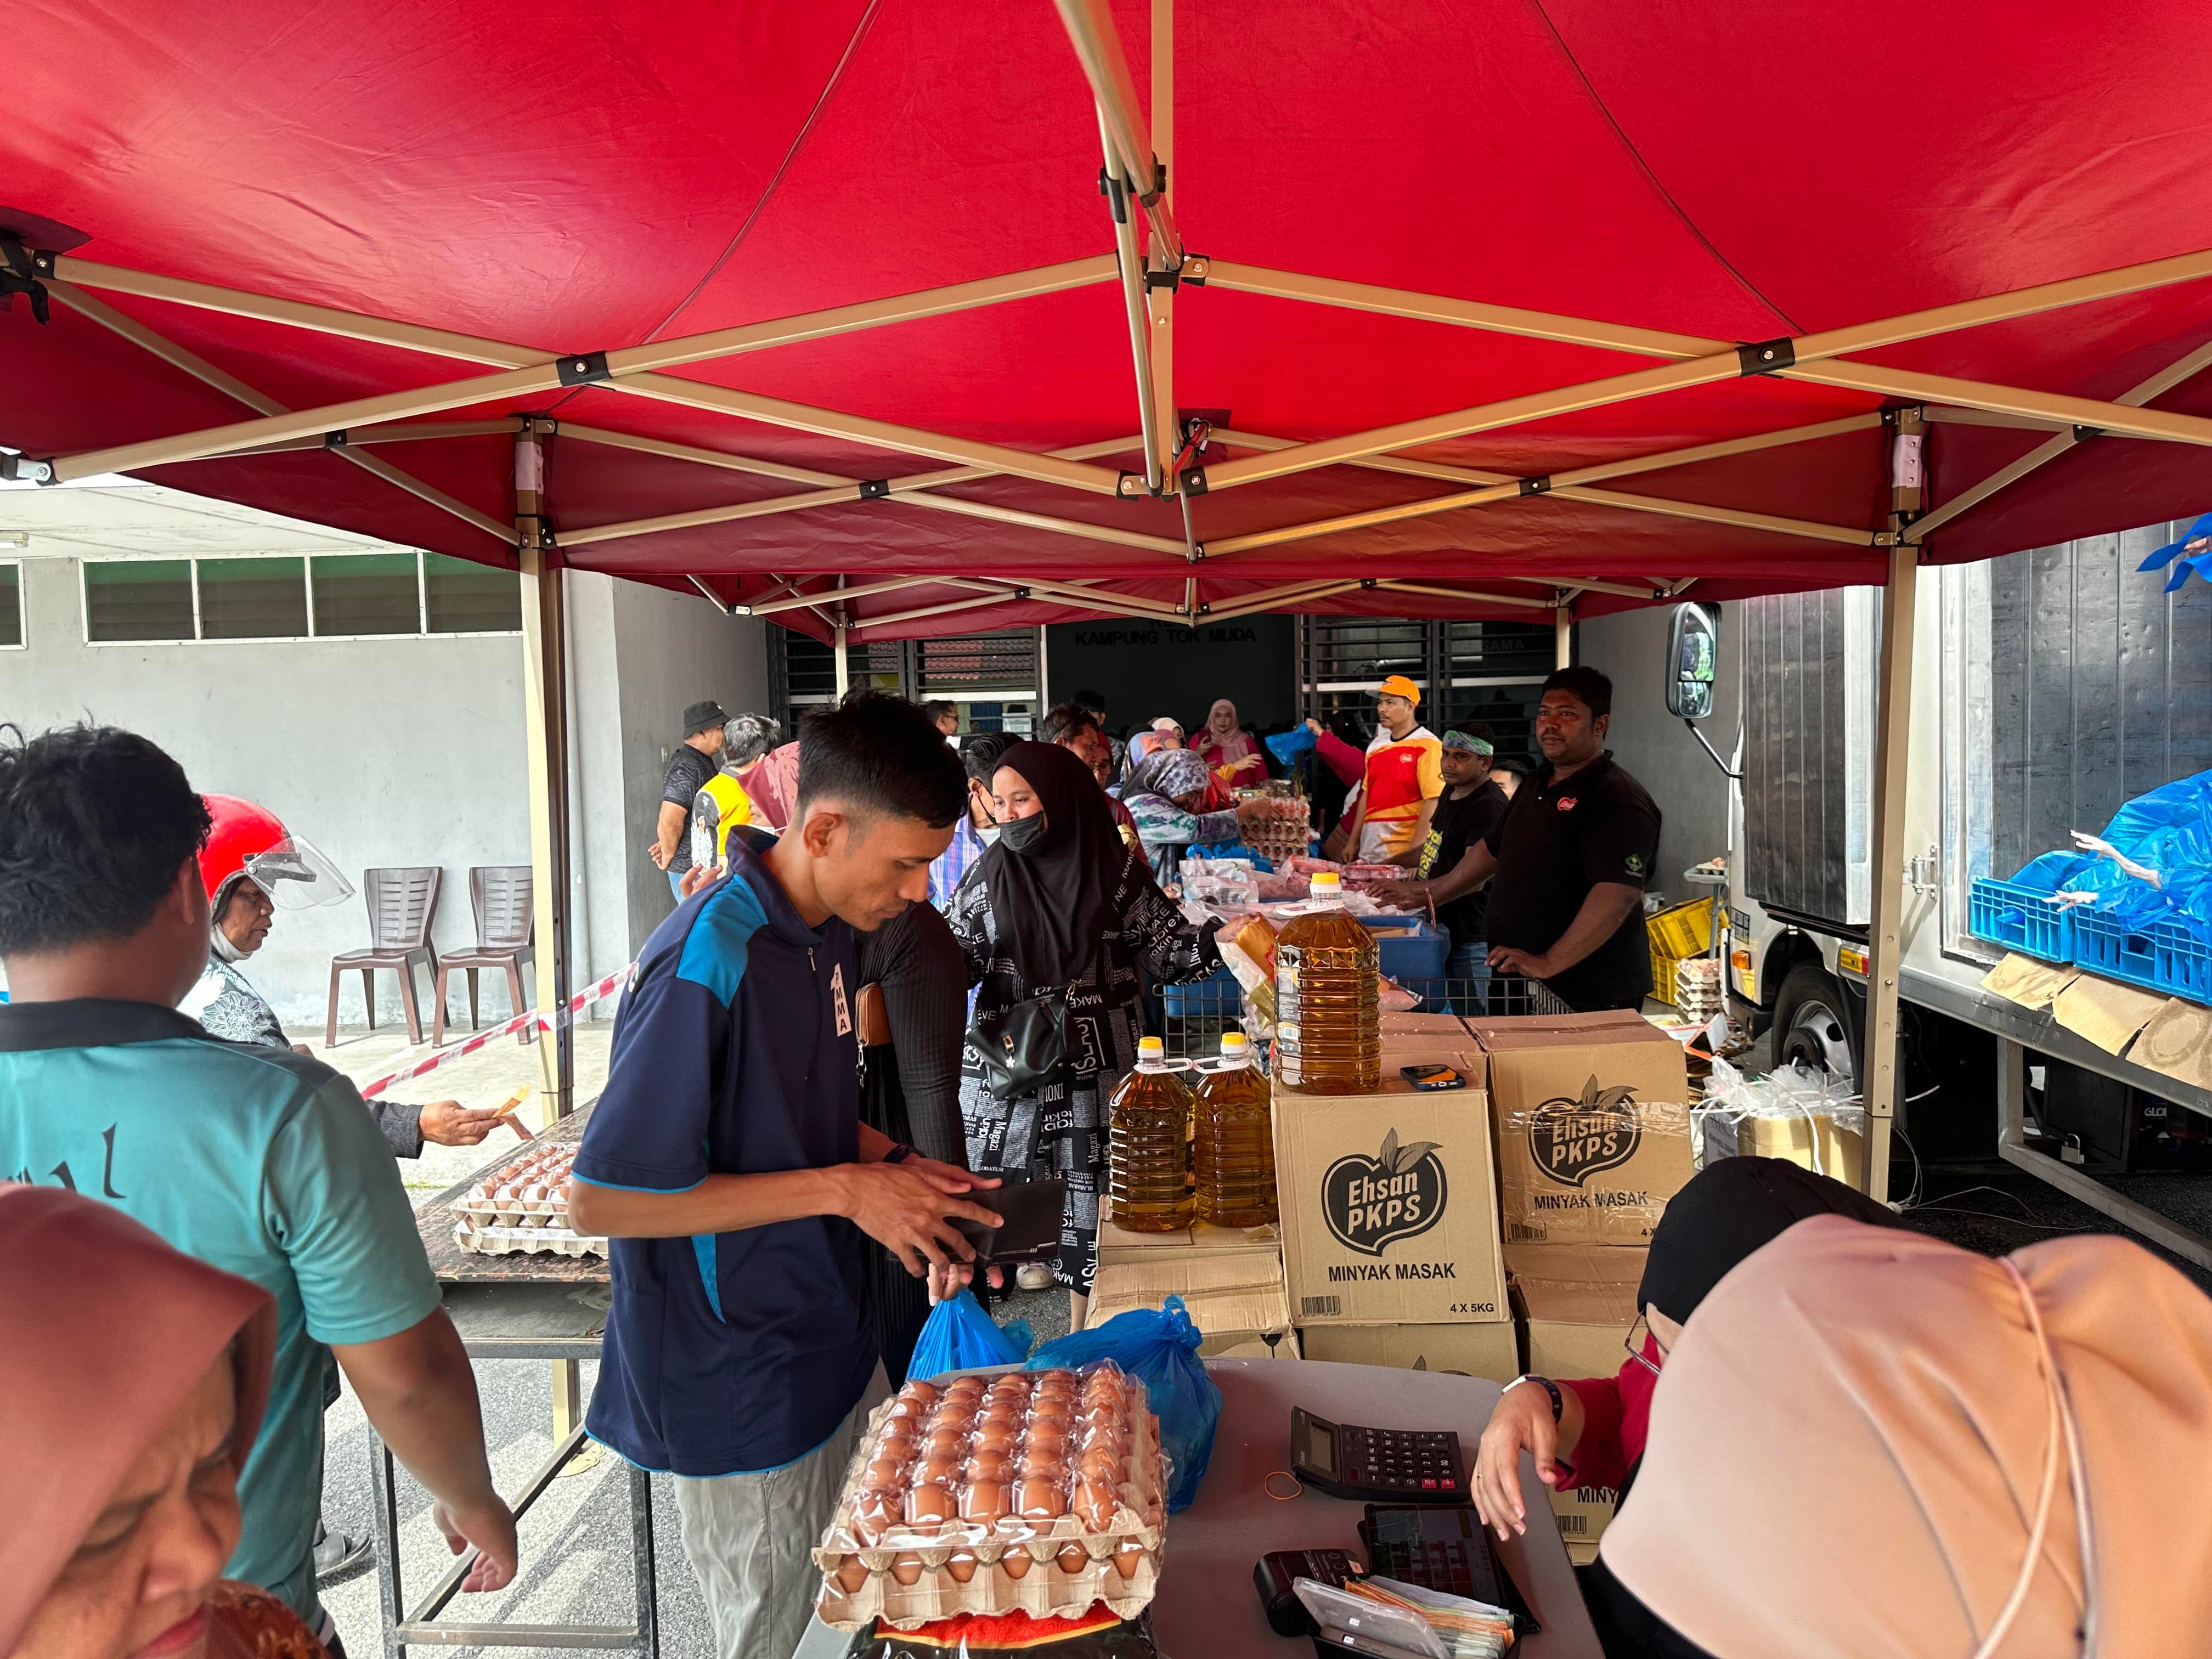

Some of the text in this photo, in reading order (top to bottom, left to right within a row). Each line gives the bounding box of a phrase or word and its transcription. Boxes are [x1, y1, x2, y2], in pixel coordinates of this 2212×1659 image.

[1075, 628, 1256, 646] KAMPUNG TOK MUDA
[835, 972, 848, 1032] PMMA
[1551, 1132, 1618, 1169] PKPS
[1348, 1171, 1418, 1207] Ehsan
[1534, 1194, 1591, 1210] MINYAK
[1594, 1191, 1649, 1207] MASAK
[1347, 1194, 1421, 1235] PKPS
[1641, 1228, 1648, 1236] 4
[1328, 1264, 1391, 1282] MINYAK
[1395, 1262, 1456, 1279] MASAK
[1450, 1303, 1494, 1312] 4 X 5KG
